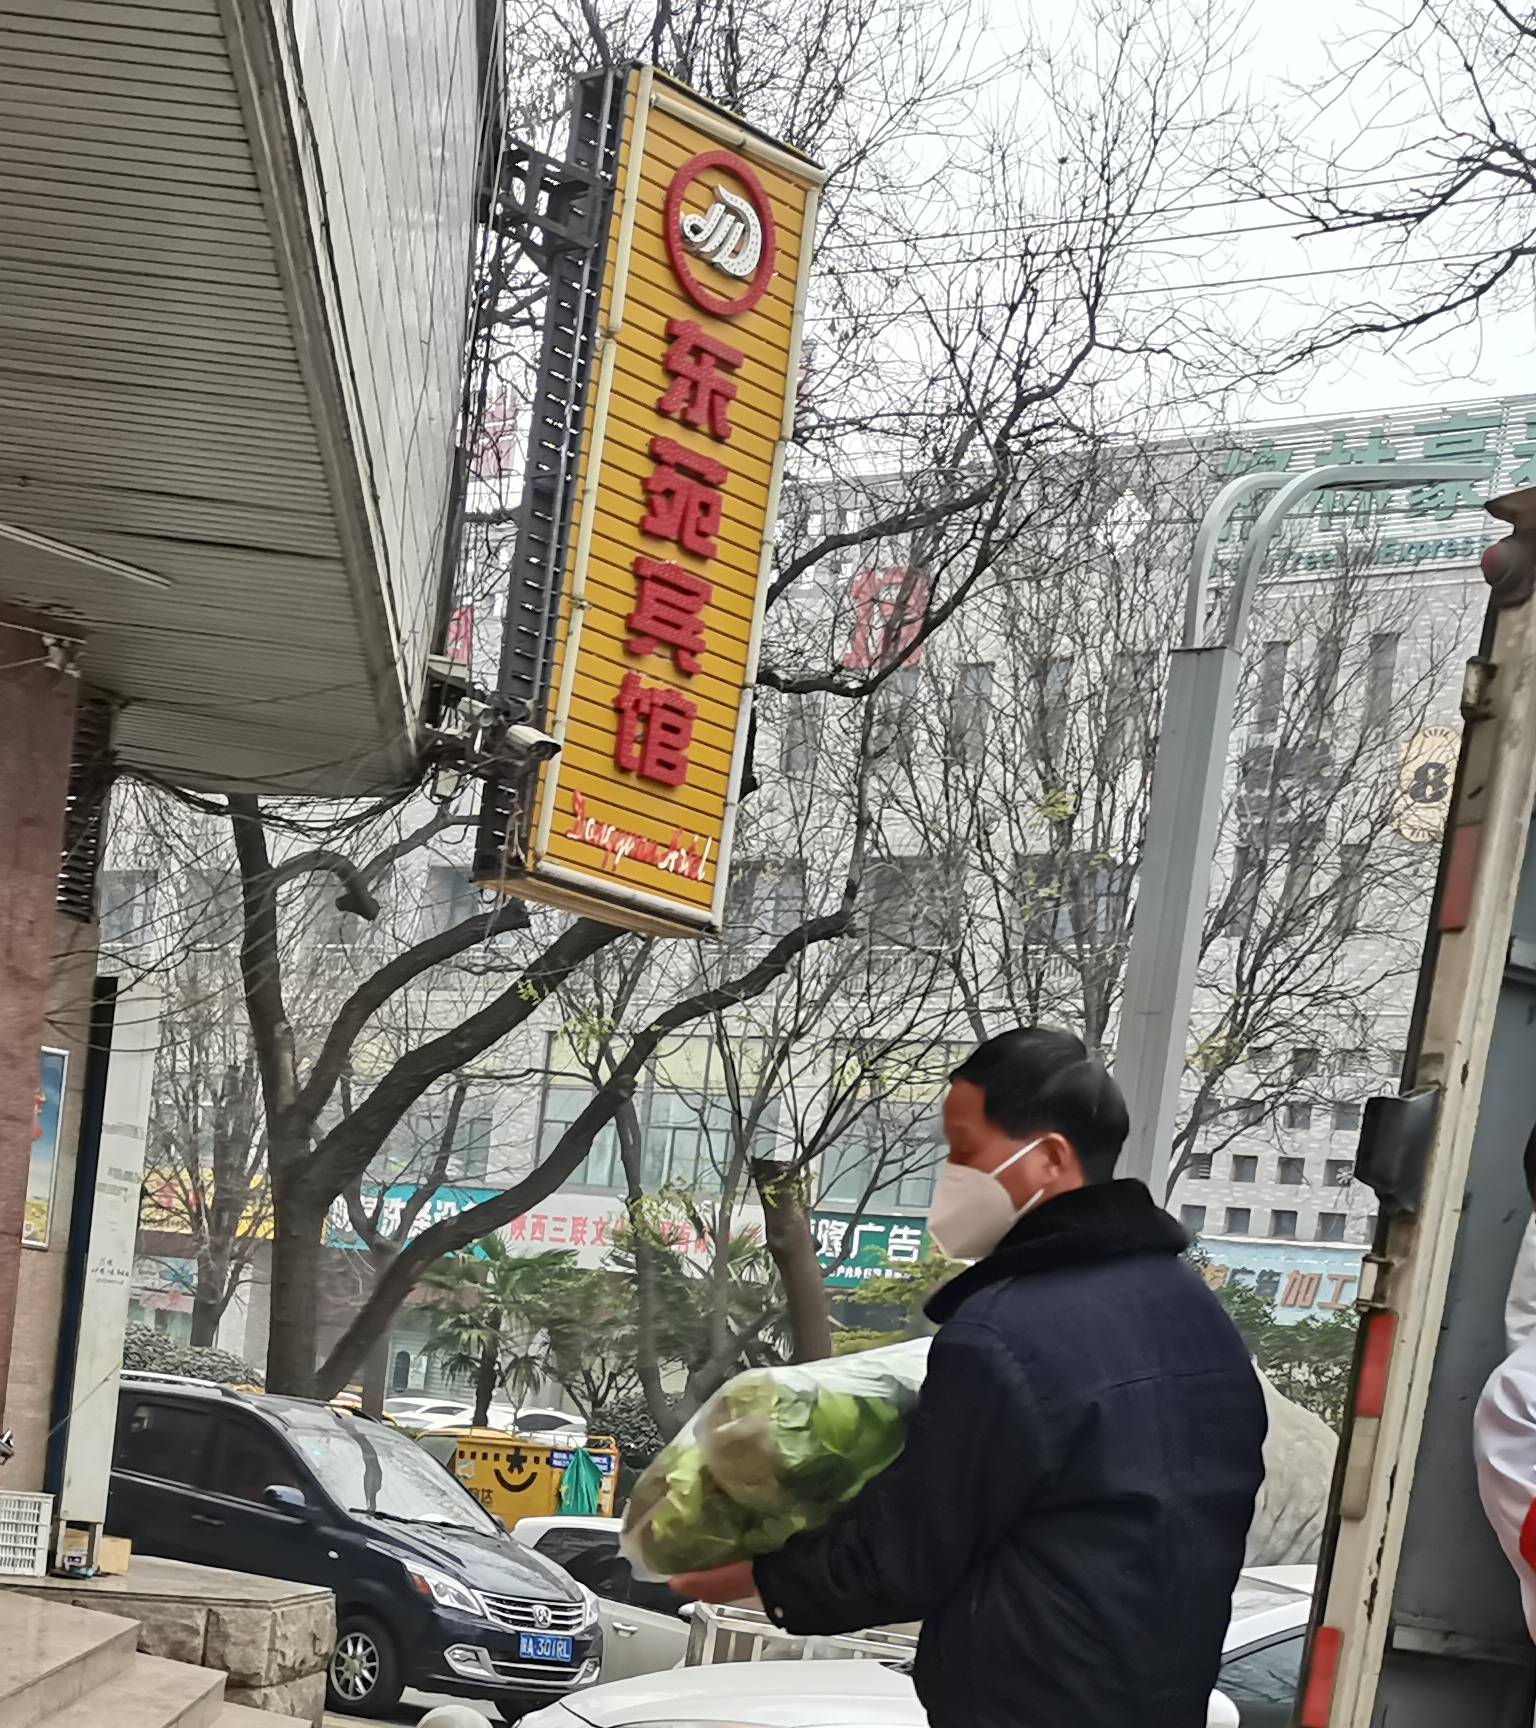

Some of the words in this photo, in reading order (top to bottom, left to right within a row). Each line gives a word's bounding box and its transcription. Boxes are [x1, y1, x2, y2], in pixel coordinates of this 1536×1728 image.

[613, 317, 744, 790] 东苑宾馆
[1409, 761, 1450, 804] 8
[810, 1217, 922, 1263] 隆广告
